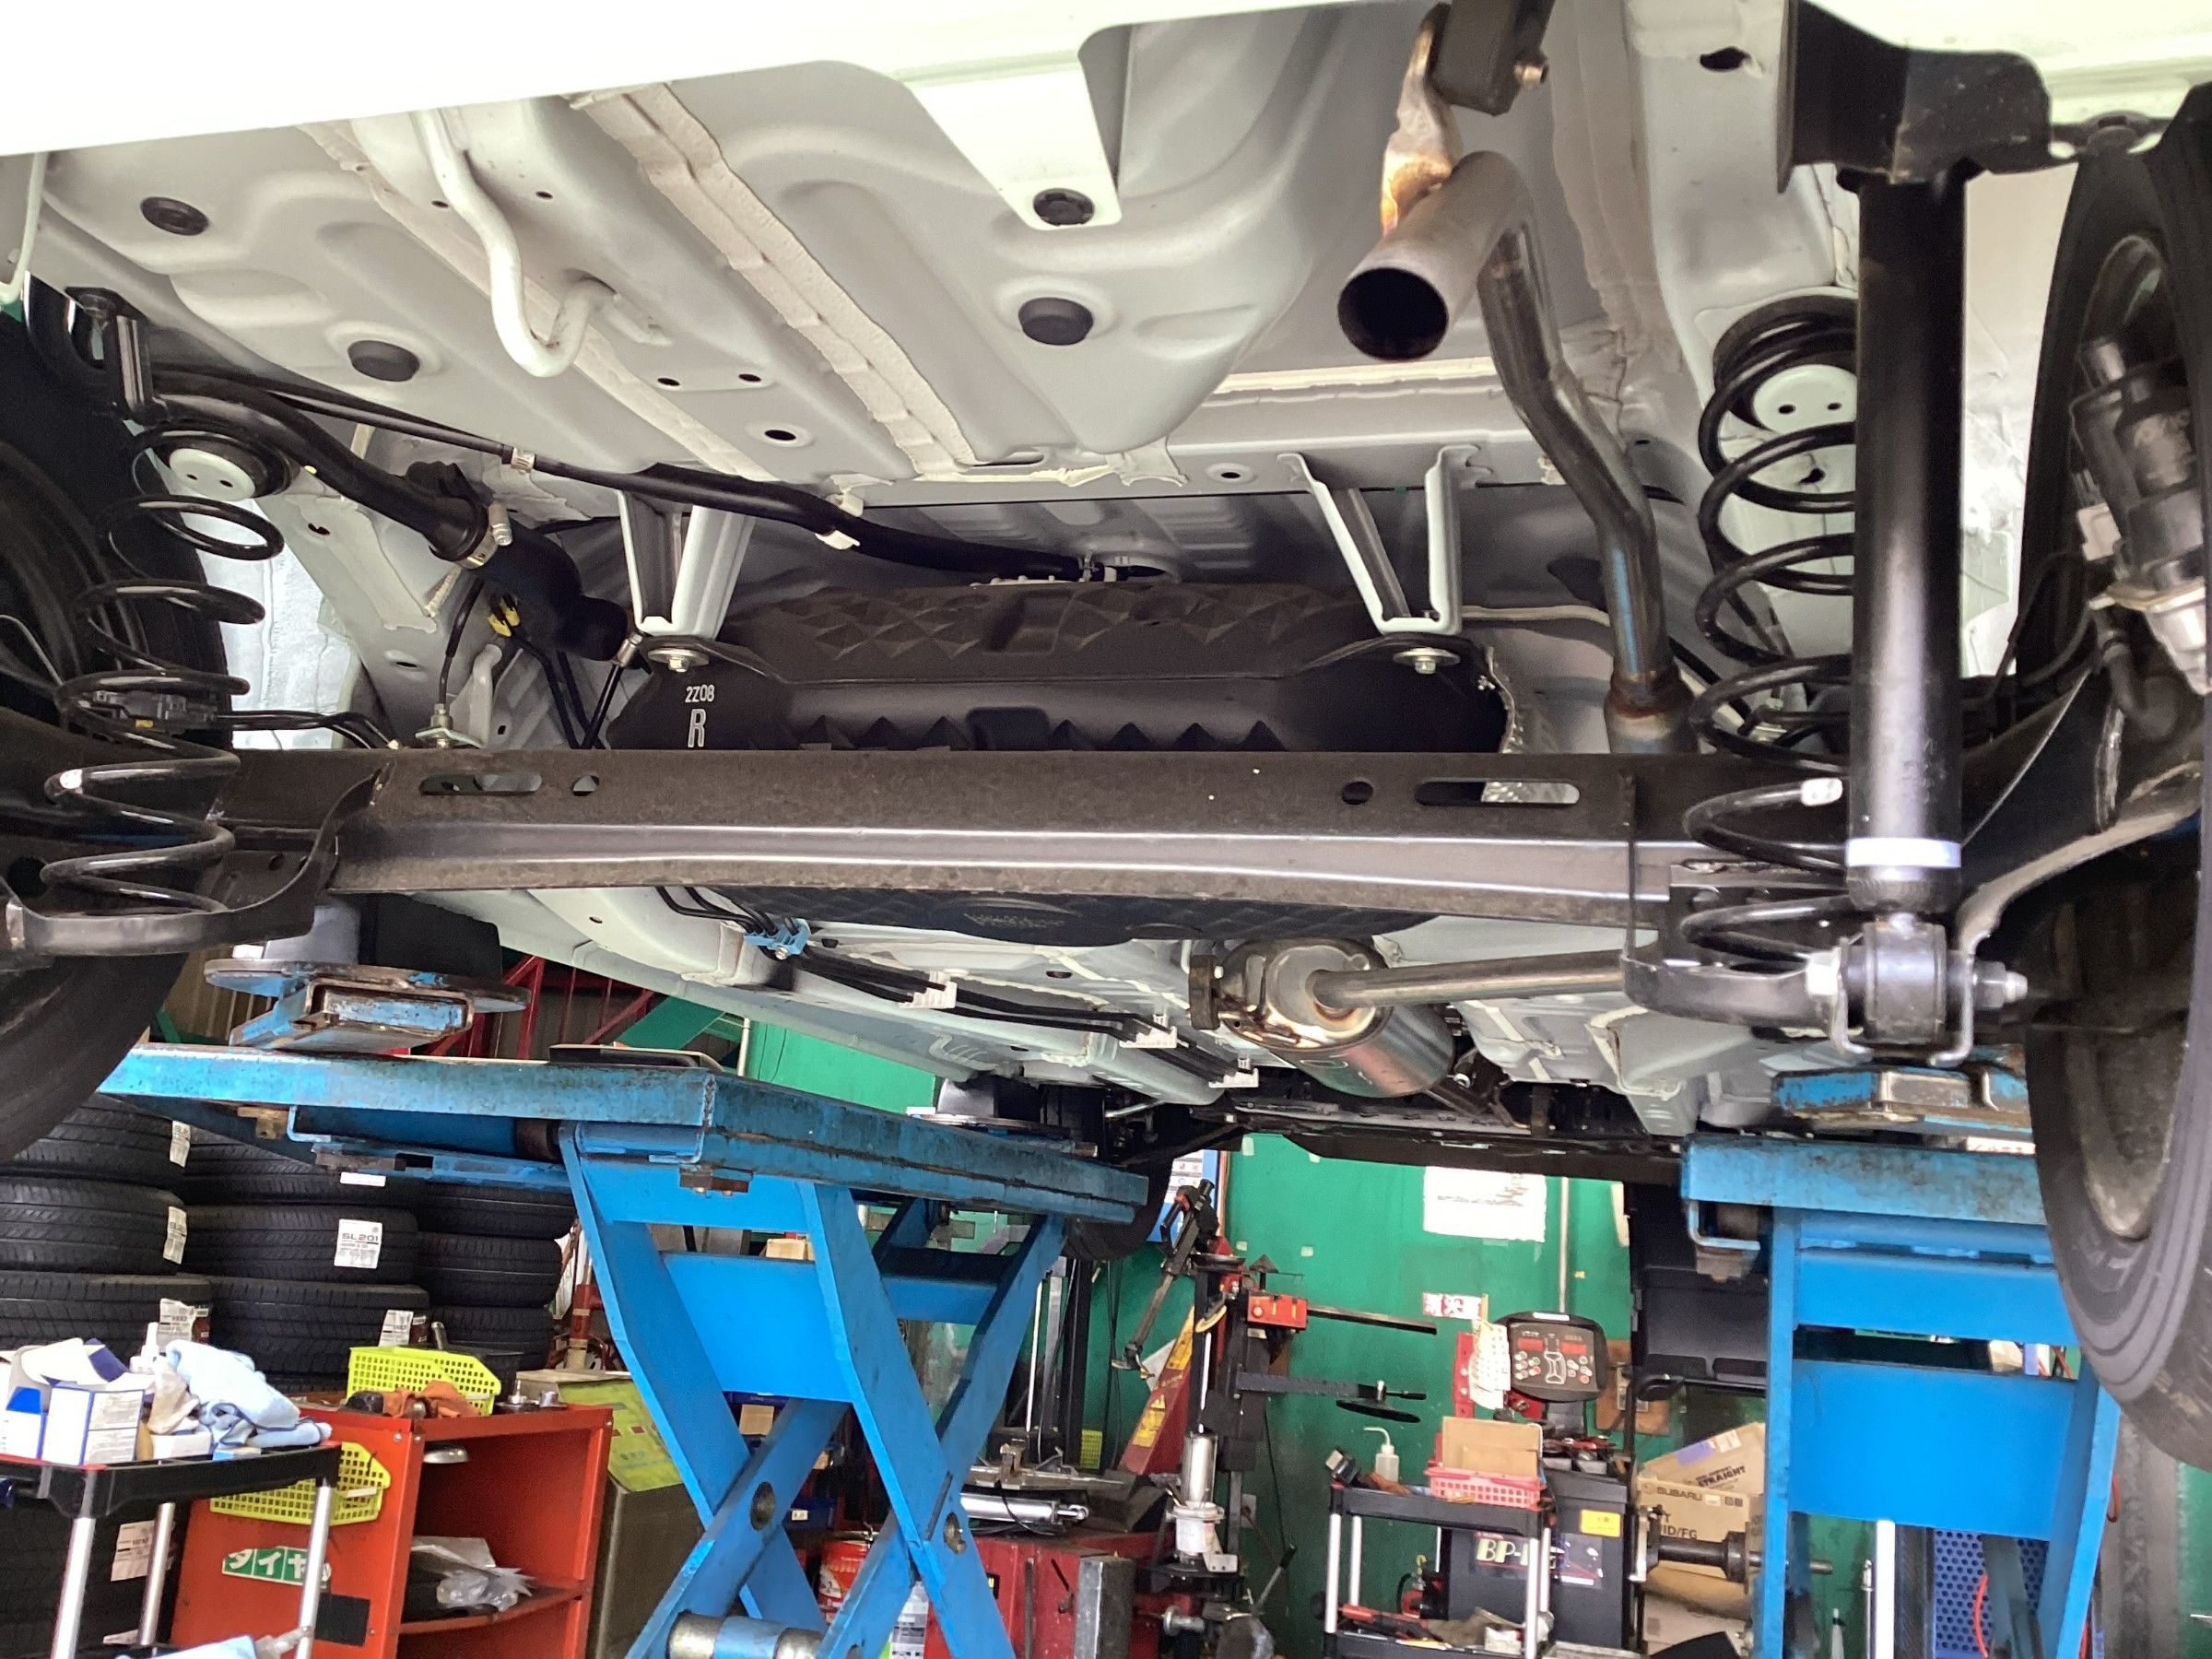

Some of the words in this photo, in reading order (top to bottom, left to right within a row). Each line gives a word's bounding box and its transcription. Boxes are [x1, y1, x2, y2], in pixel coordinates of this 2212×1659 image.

[688, 708, 707, 747] R
[342, 1232, 379, 1242] SL201
[1656, 1487, 1702, 1501] SUBARU
